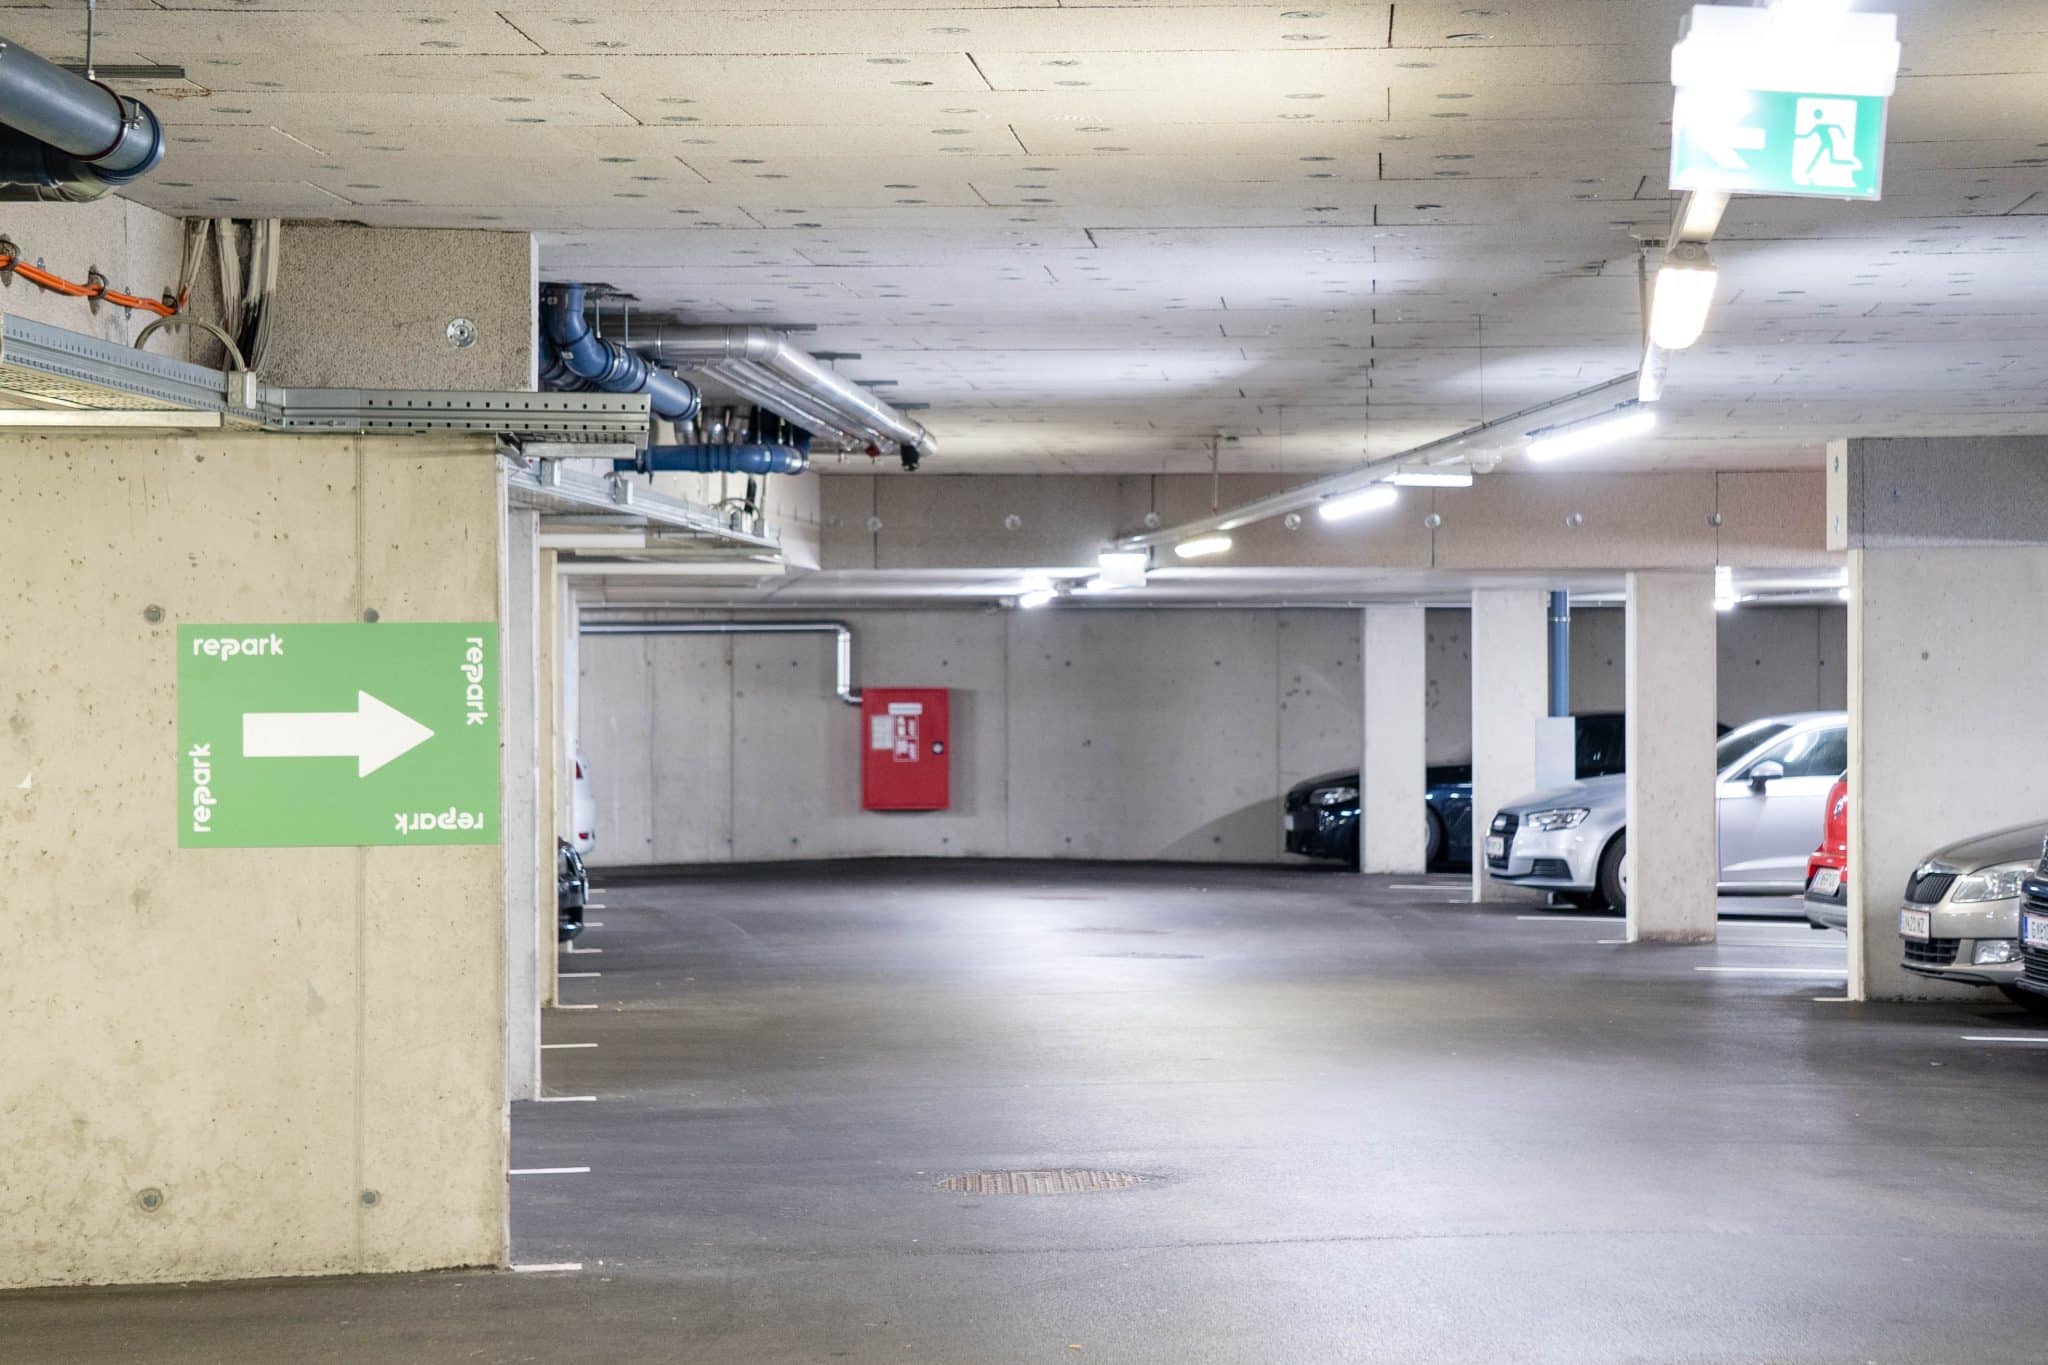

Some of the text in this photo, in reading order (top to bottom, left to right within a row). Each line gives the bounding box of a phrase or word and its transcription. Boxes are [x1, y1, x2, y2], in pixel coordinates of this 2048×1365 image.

[192, 633, 284, 661] repark
[461, 637, 488, 726] repark
[188, 743, 217, 832] repark
[394, 807, 484, 835] repark
